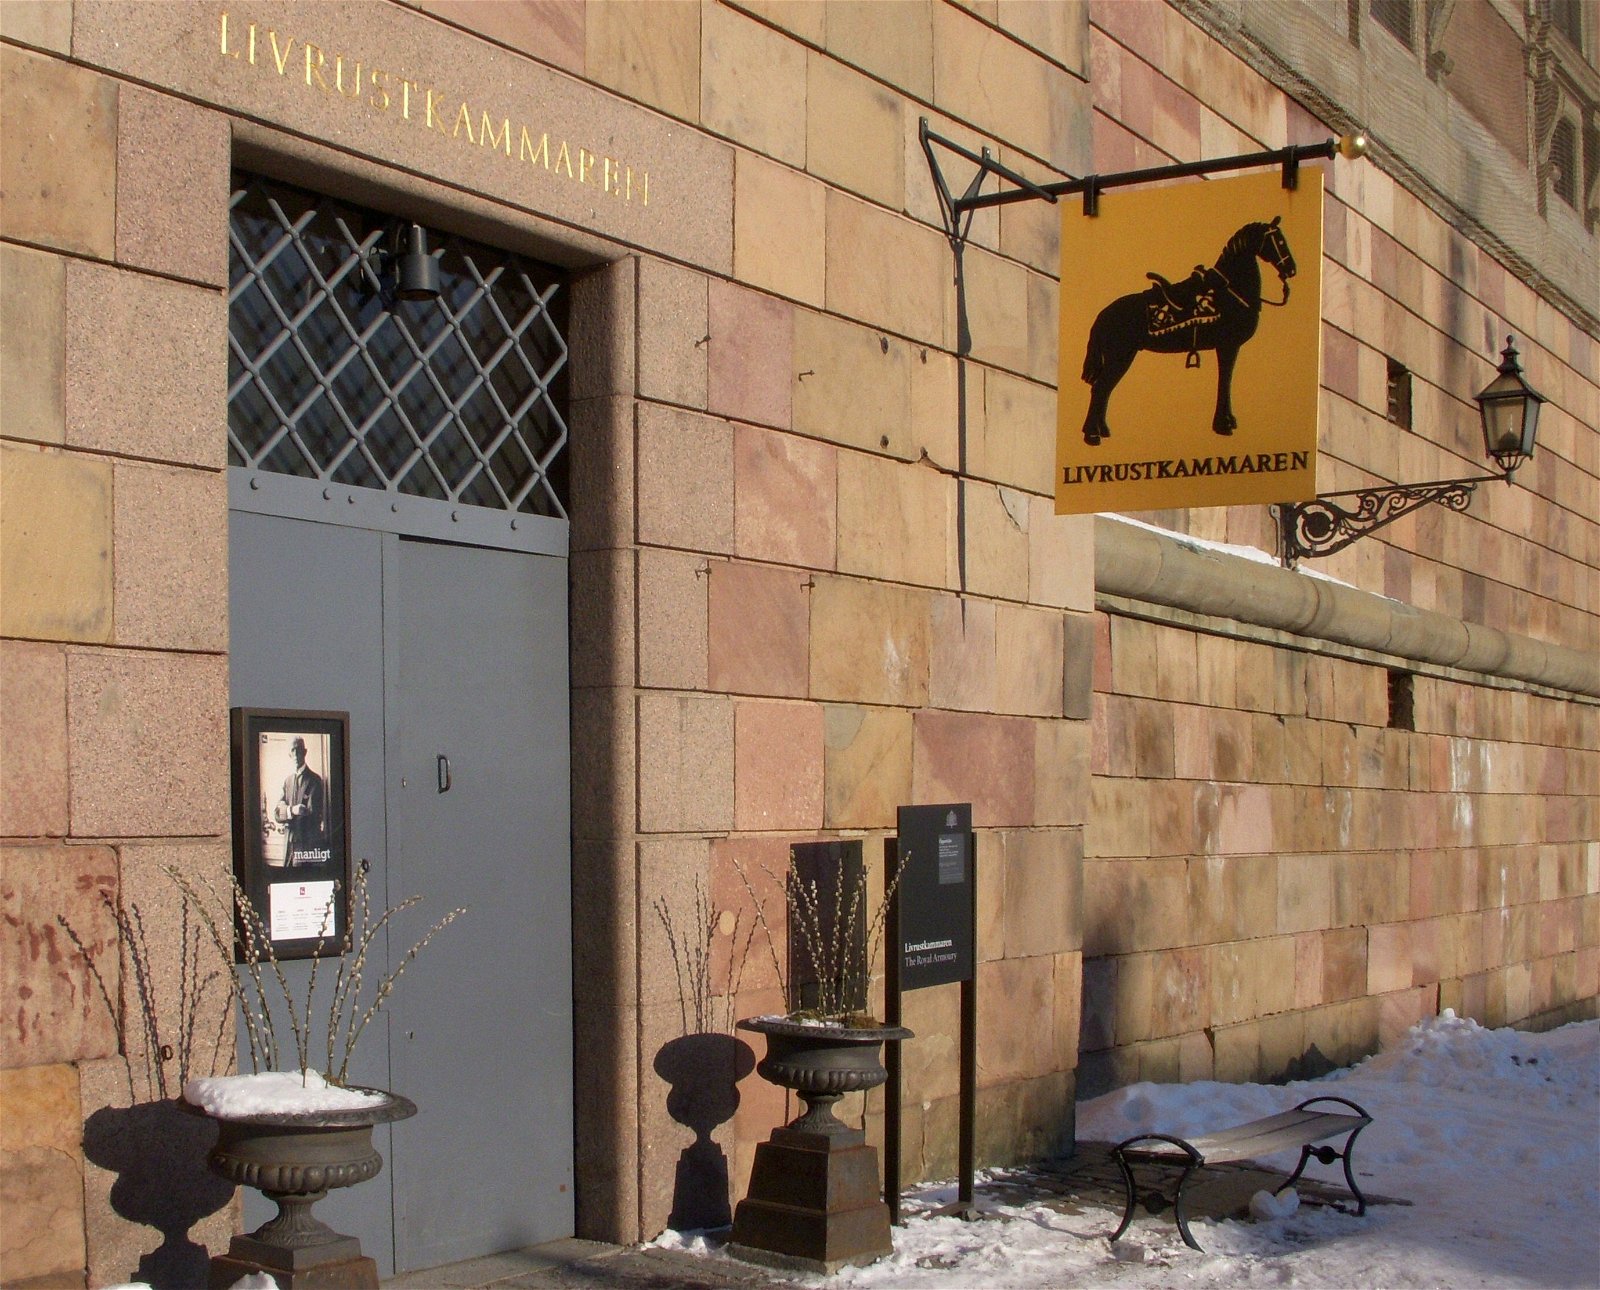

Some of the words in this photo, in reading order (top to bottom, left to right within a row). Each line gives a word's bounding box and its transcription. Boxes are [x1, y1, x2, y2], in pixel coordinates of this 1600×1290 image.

[219, 11, 649, 206] LIVRUSTKAMMAREN
[1063, 451, 1309, 484] LIVRUSTKAMMAREN
[293, 848, 331, 862] manligt
[904, 939, 953, 953] Livrustkammaren
[905, 956, 916, 967] The
[916, 953, 933, 967] Royal
[933, 952, 957, 963] Armoury
